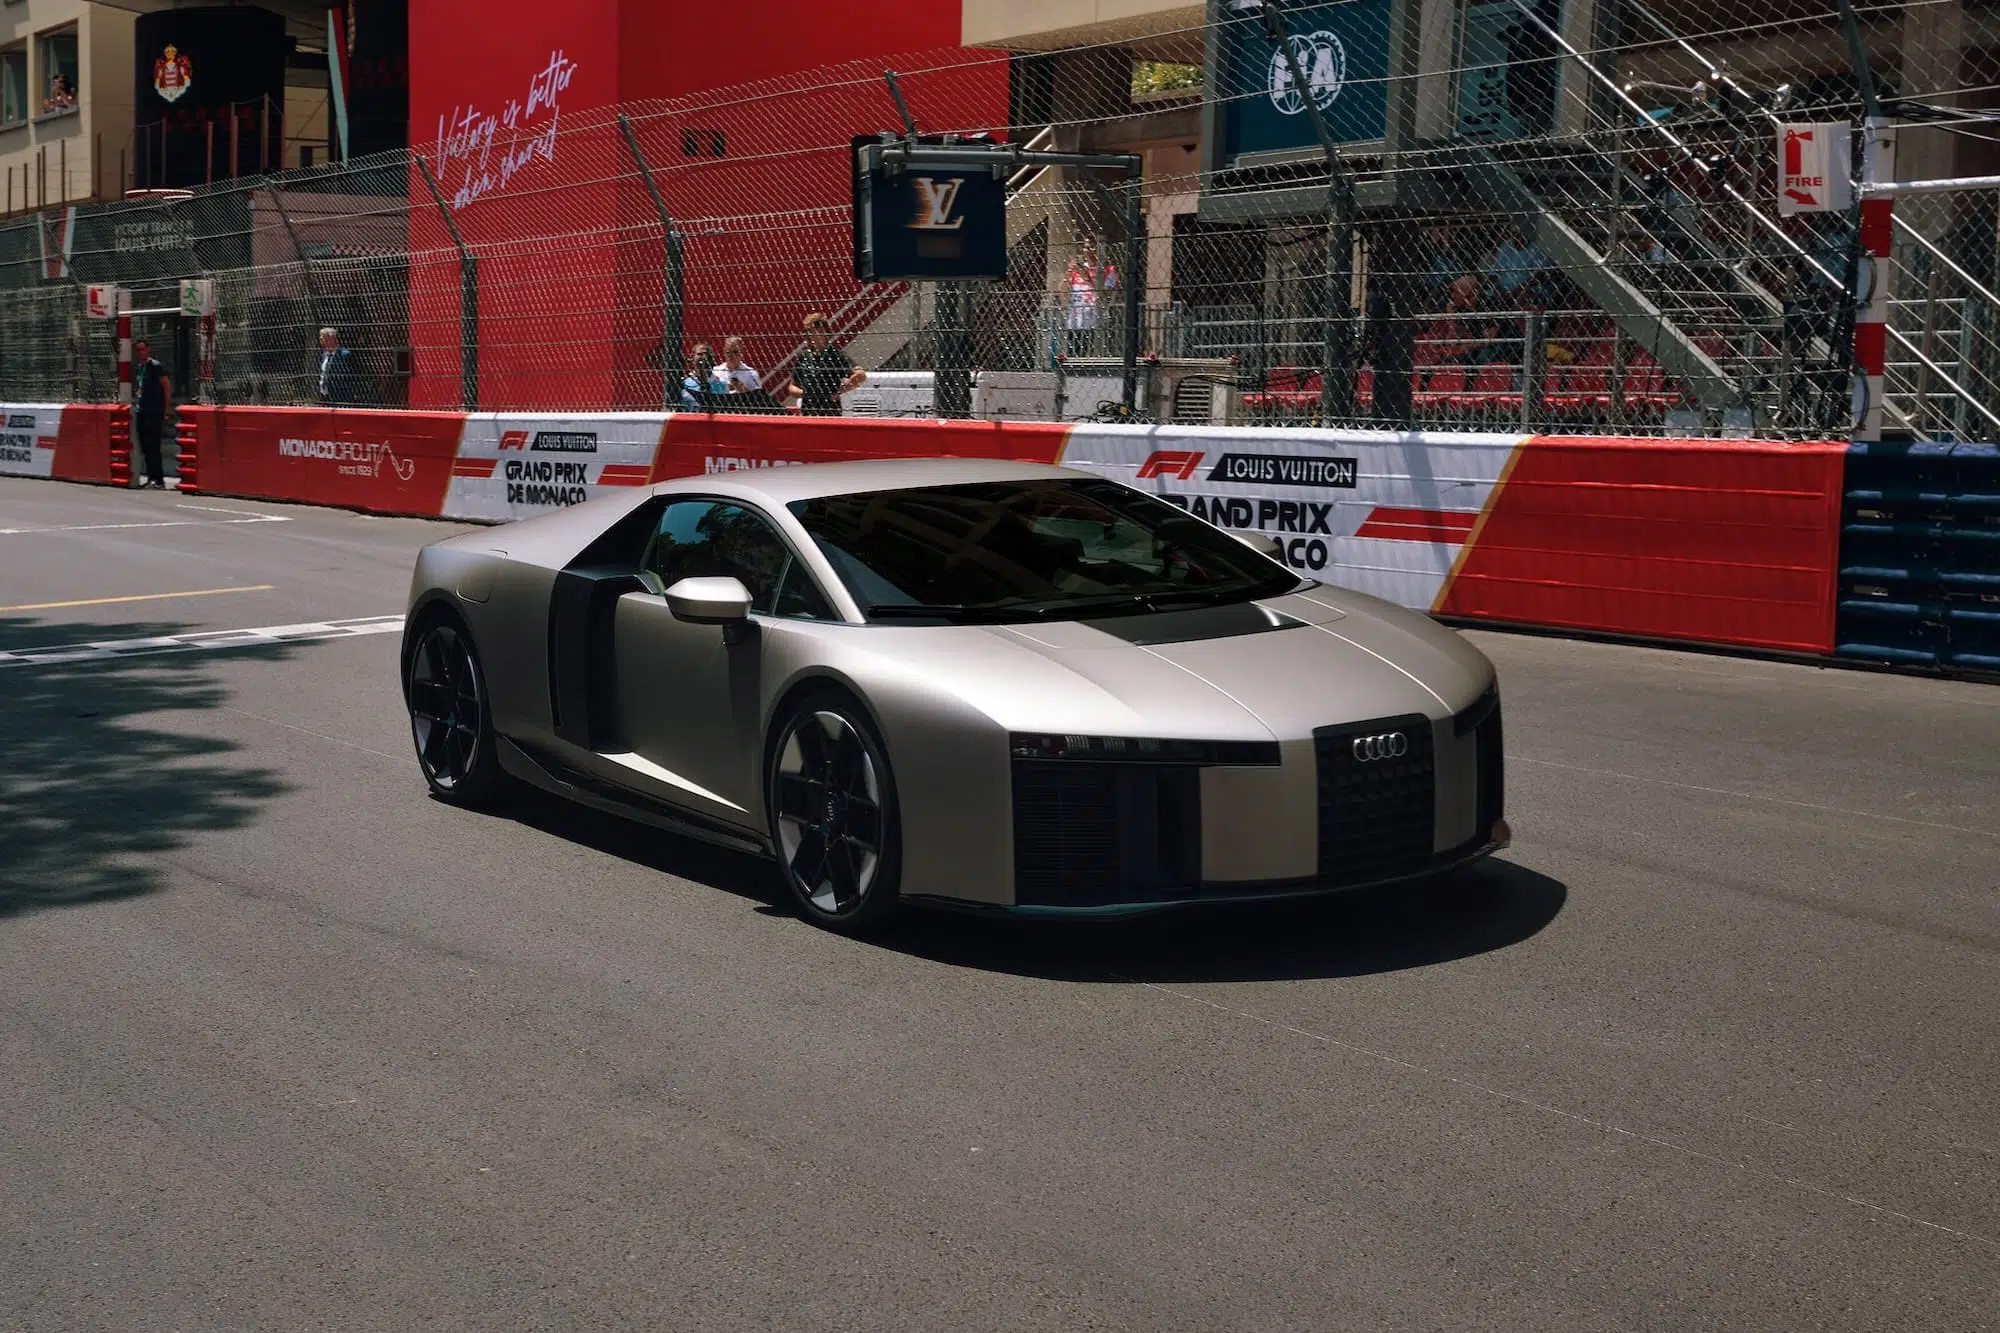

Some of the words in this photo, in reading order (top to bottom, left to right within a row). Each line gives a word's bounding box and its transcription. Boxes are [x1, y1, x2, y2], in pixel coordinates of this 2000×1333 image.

[437, 104, 498, 180] Victory
[503, 99, 522, 129] is
[525, 49, 578, 120] better
[454, 165, 498, 209] when
[501, 104, 560, 189] shared
[1785, 177, 1823, 187] FIRE
[538, 435, 561, 449] LOUIS
[562, 435, 596, 450] VUITTON
[506, 460, 552, 482] GRAND
[554, 462, 588, 485] PRIX
[1226, 457, 1274, 481] LOUIS
[1279, 459, 1353, 484] VUITTON
[507, 483, 524, 504] DE
[525, 484, 587, 507] MONACO
[1258, 499, 1334, 535] PRIX
